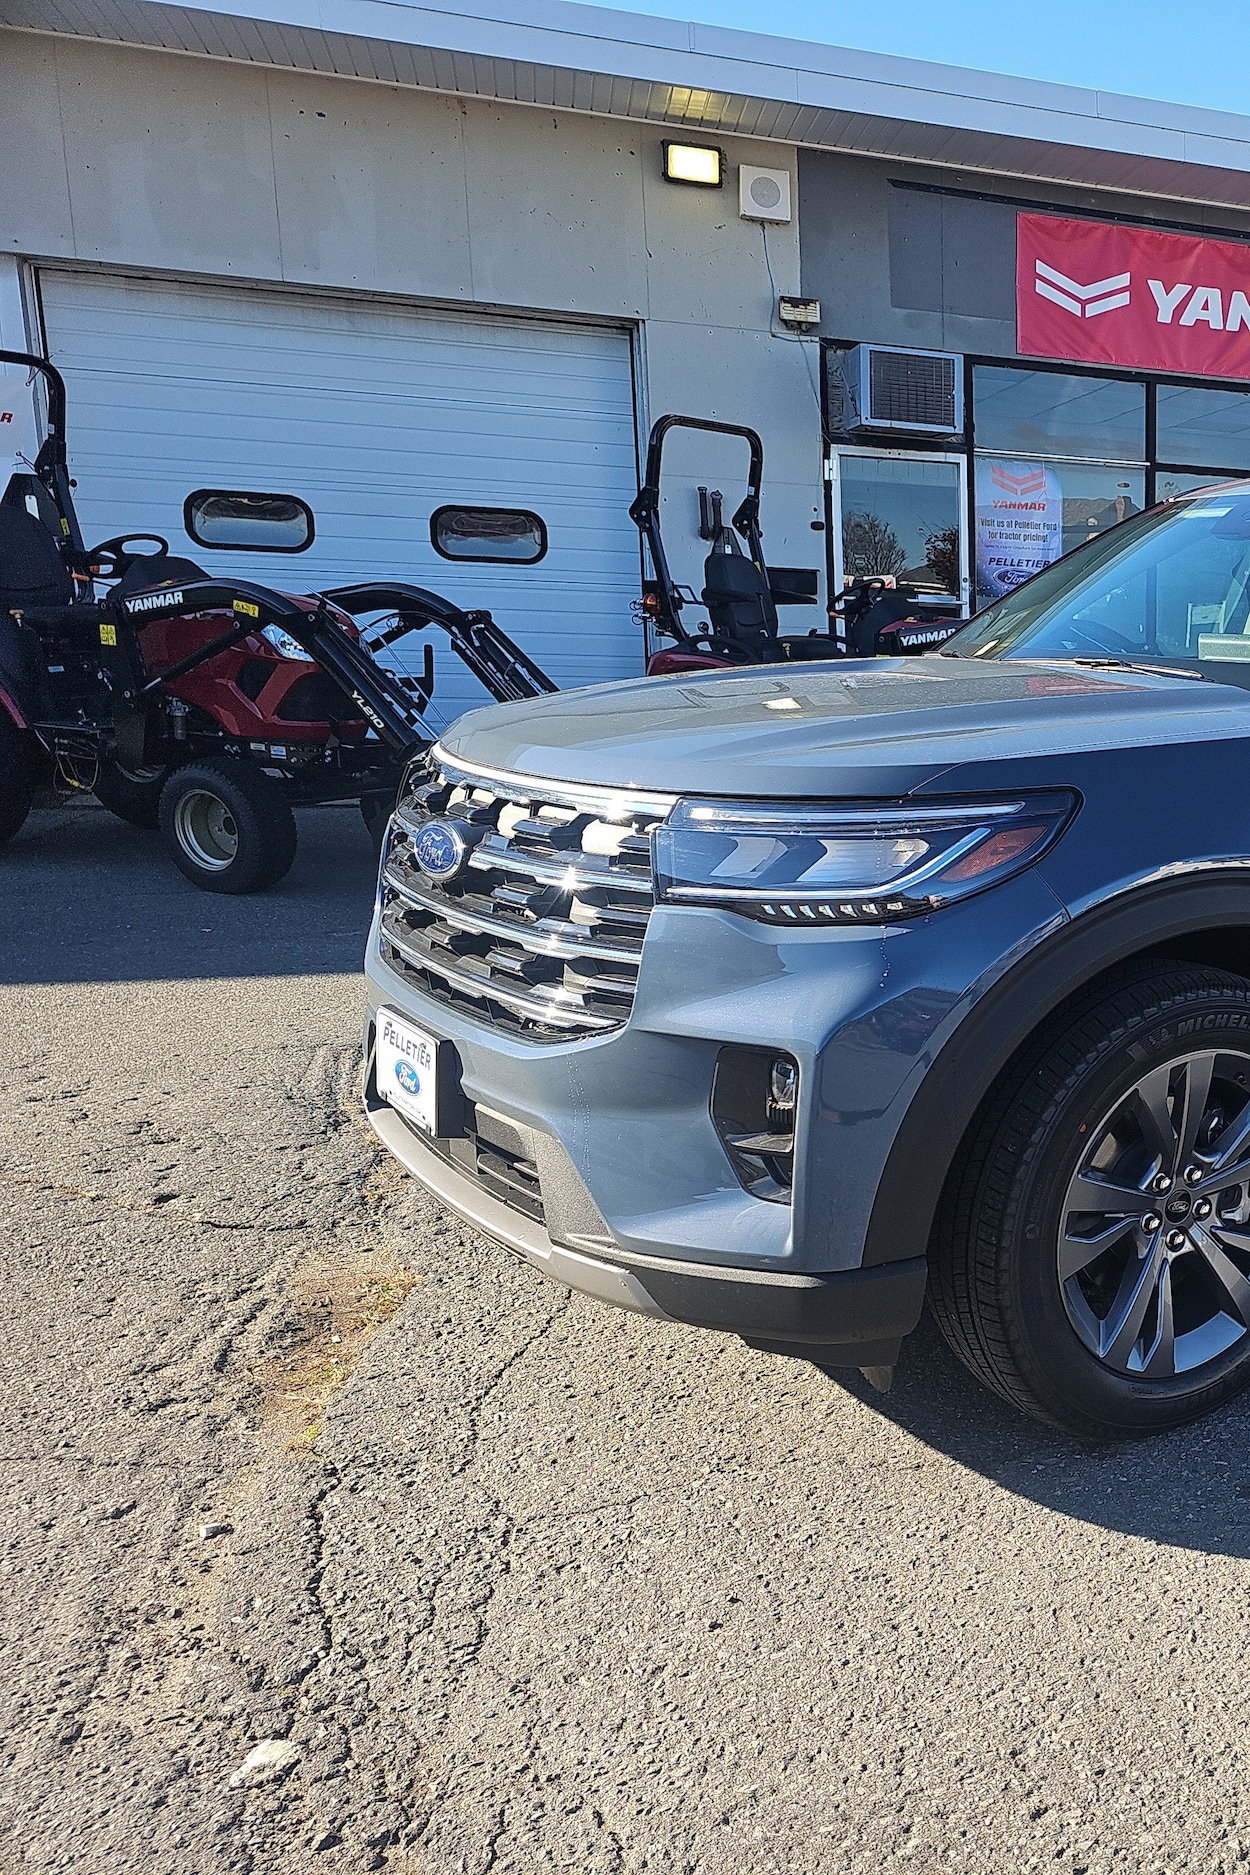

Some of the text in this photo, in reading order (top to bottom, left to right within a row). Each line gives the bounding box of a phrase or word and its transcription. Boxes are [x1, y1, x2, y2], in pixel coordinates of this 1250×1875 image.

[992, 499, 1046, 511] YANMAR
[980, 518, 1057, 531] Visit us at Pelletier Ford
[988, 530, 1048, 543] for tractor pricing!
[988, 557, 1050, 568] PELLETIER
[125, 591, 184, 614] YANMAR
[352, 690, 385, 728] YL210
[419, 831, 448, 866] Ford
[383, 1026, 431, 1070] PELLETIER
[399, 1064, 417, 1091] Ford
